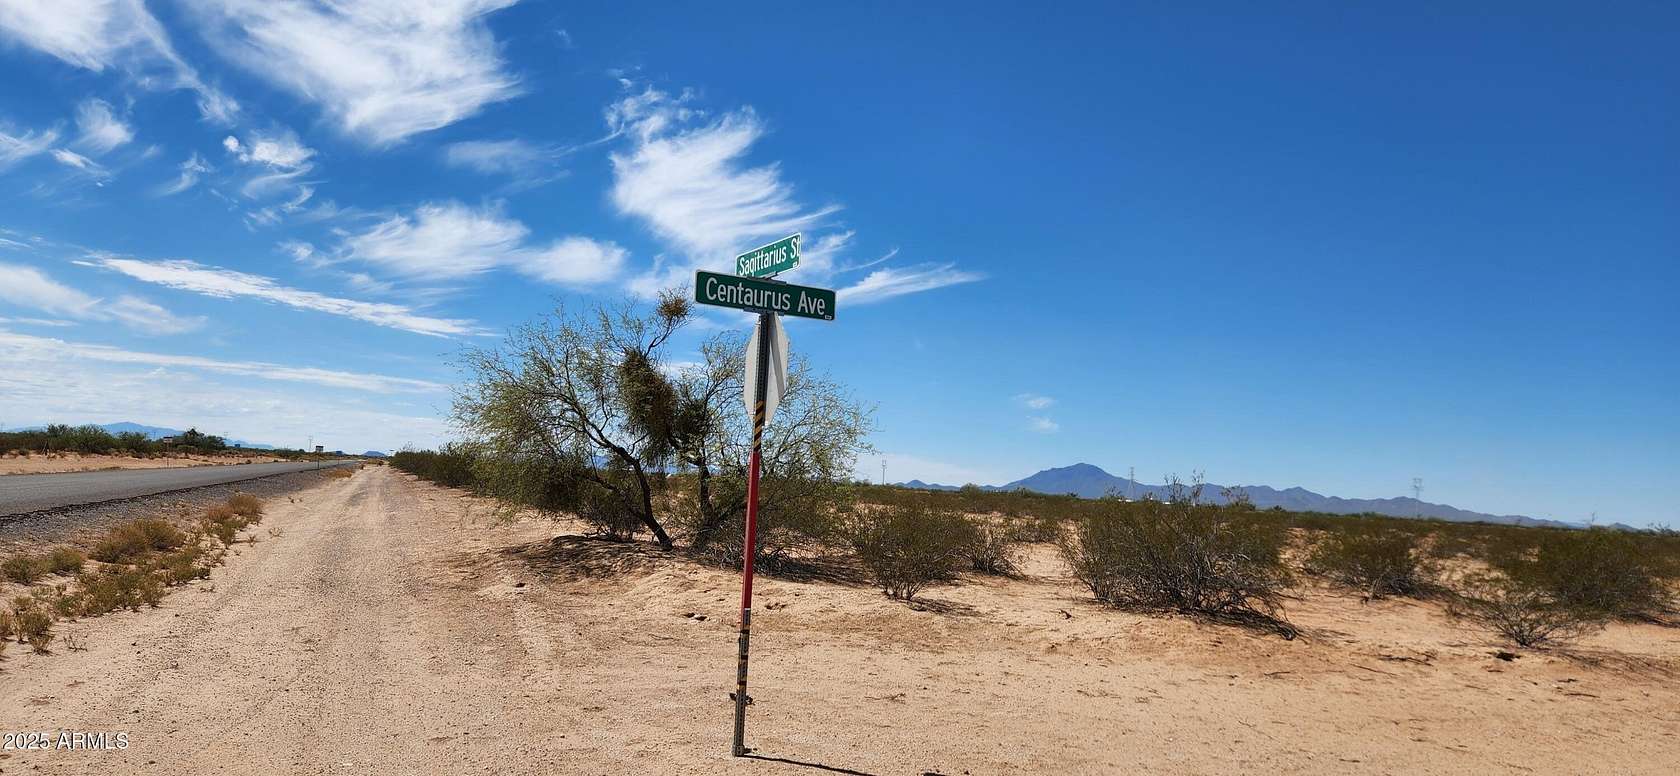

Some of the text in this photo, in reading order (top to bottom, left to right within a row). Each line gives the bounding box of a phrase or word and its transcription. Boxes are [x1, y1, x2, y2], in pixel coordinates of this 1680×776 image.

[739, 237, 800, 276] Sagittarius St
[705, 277, 826, 315] Centaurus Ave
